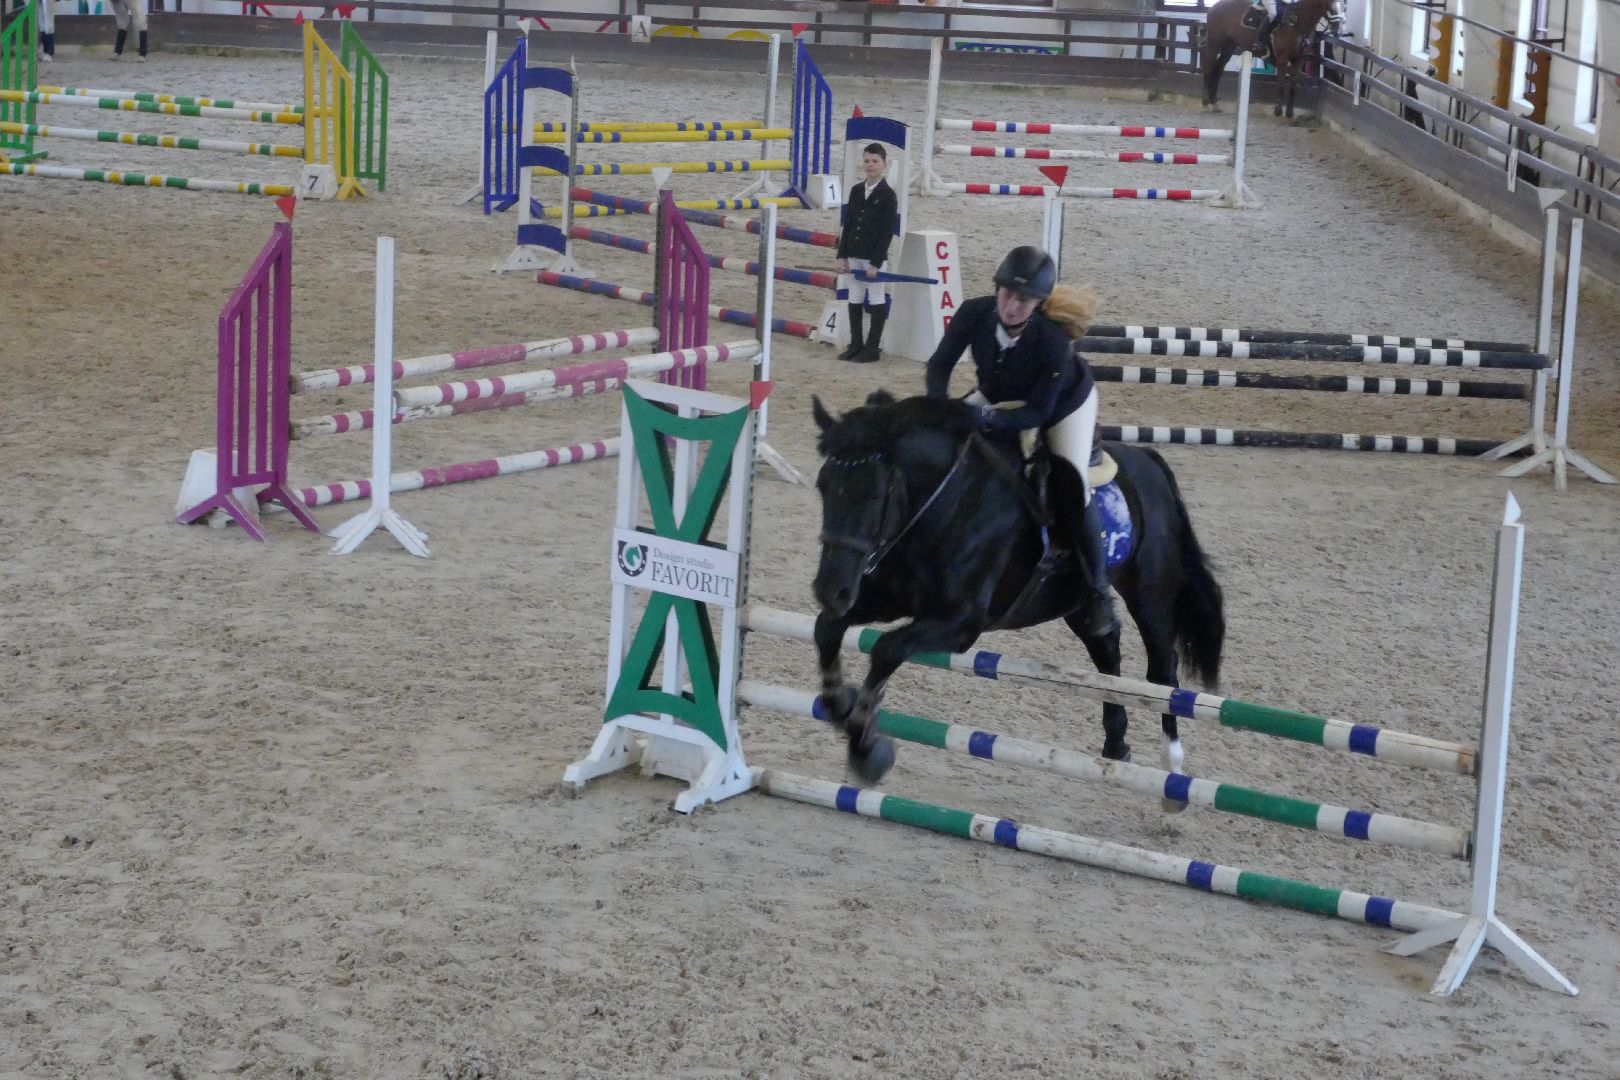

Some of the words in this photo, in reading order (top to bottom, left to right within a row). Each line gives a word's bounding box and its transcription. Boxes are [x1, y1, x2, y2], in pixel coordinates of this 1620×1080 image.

[634, 20, 649, 37] A
[309, 175, 319, 190] 7
[828, 183, 836, 200] 1
[935, 241, 955, 333] СТАР
[826, 312, 837, 333] 4
[654, 548, 684, 564] Design
[687, 558, 715, 569] studio
[651, 561, 734, 598] FAVORIT
